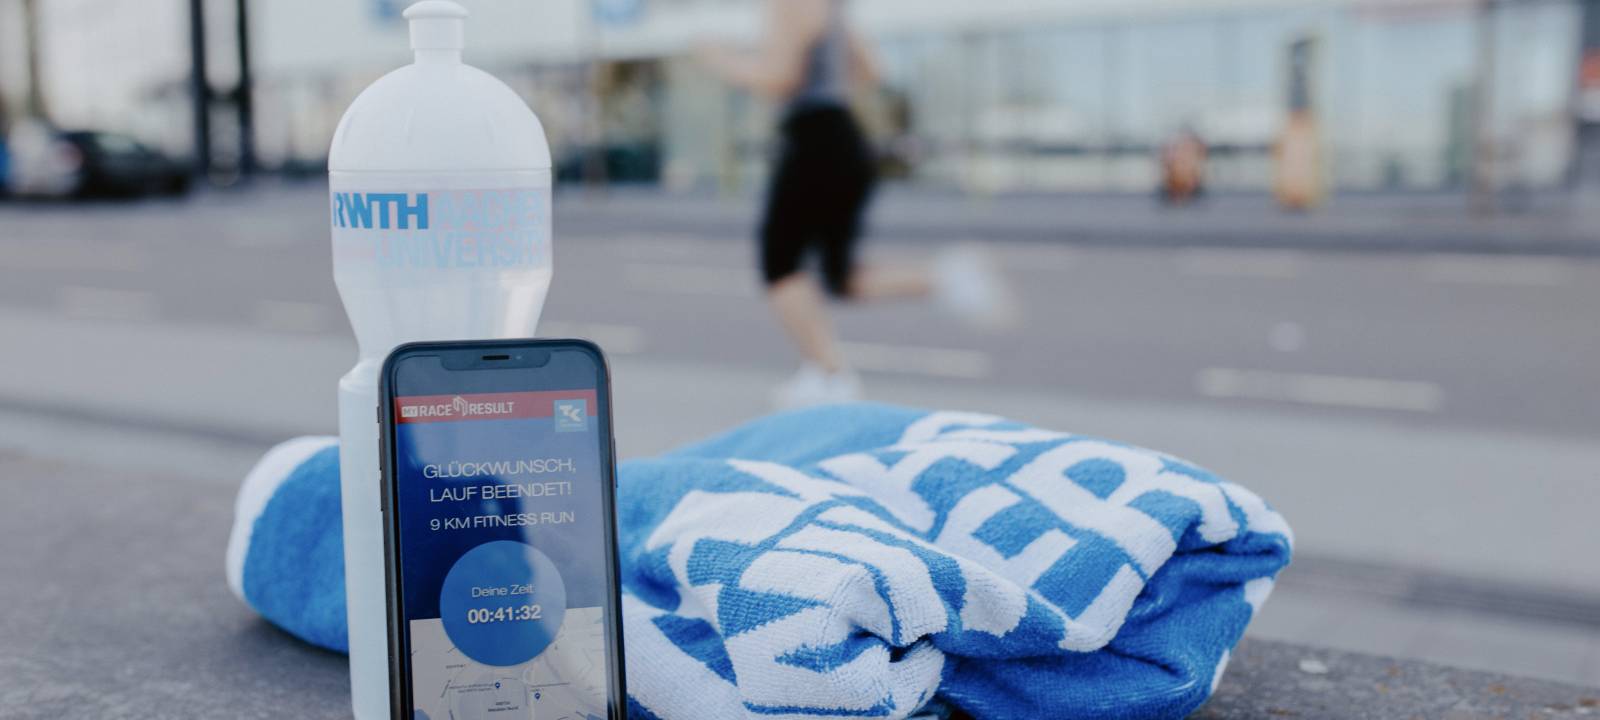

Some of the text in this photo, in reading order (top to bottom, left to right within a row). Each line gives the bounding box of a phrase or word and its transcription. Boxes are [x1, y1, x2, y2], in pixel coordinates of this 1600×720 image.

[333, 192, 429, 230] RWTH
[419, 403, 452, 417] RACE
[469, 401, 514, 416] RESULT
[423, 457, 577, 479] GLÜCKWUNSCH,
[430, 481, 572, 502] LAUF BEENDET!
[430, 511, 575, 531] 9 KM FITNESS RUN
[471, 583, 535, 598] Deine Zeit
[467, 604, 542, 624] 00:41:32
